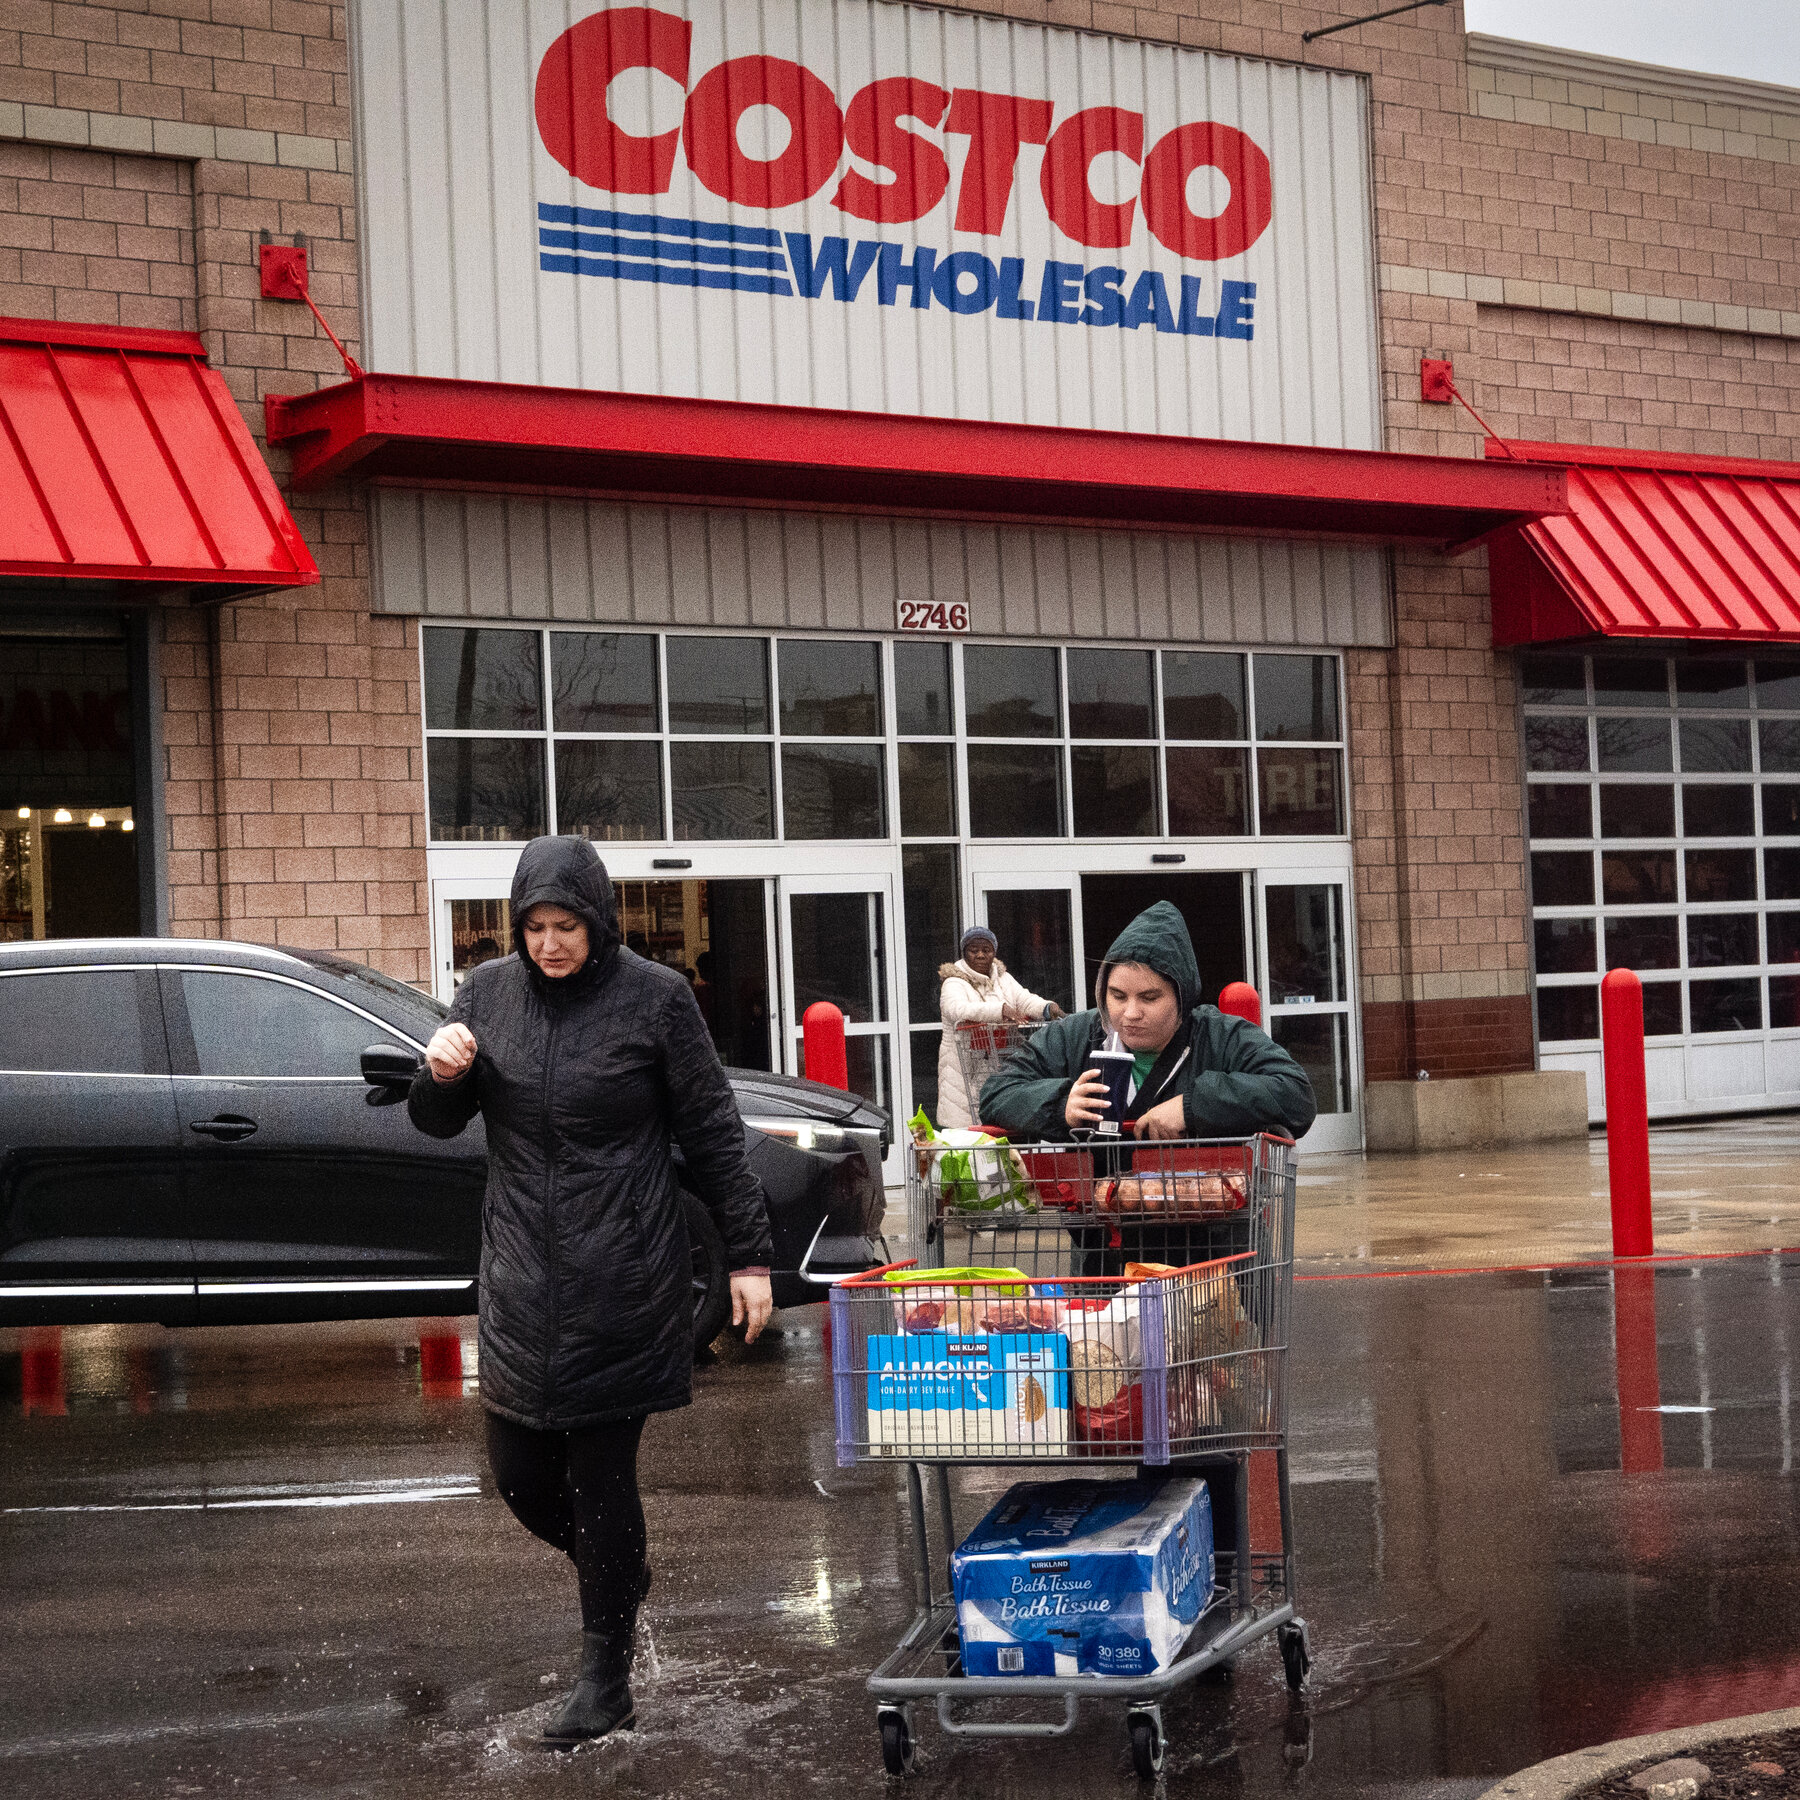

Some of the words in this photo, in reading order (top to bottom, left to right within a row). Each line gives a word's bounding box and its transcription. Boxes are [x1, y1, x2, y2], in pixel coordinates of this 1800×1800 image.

[534, 6, 1272, 261] COSTCO
[783, 231, 1257, 341] WHOLESALE
[900, 601, 968, 630] 2746
[880, 1360, 994, 1381] ALMOND
[1031, 1560, 1069, 1569] KIRKLAND
[1011, 1576, 1050, 1594] Bath
[1049, 1574, 1093, 1591] Tissue
[1000, 1596, 1053, 1620] Bath
[1052, 1593, 1111, 1615] Tissue
[1098, 1645, 1112, 1658] 30
[1115, 1646, 1141, 1658] 380
